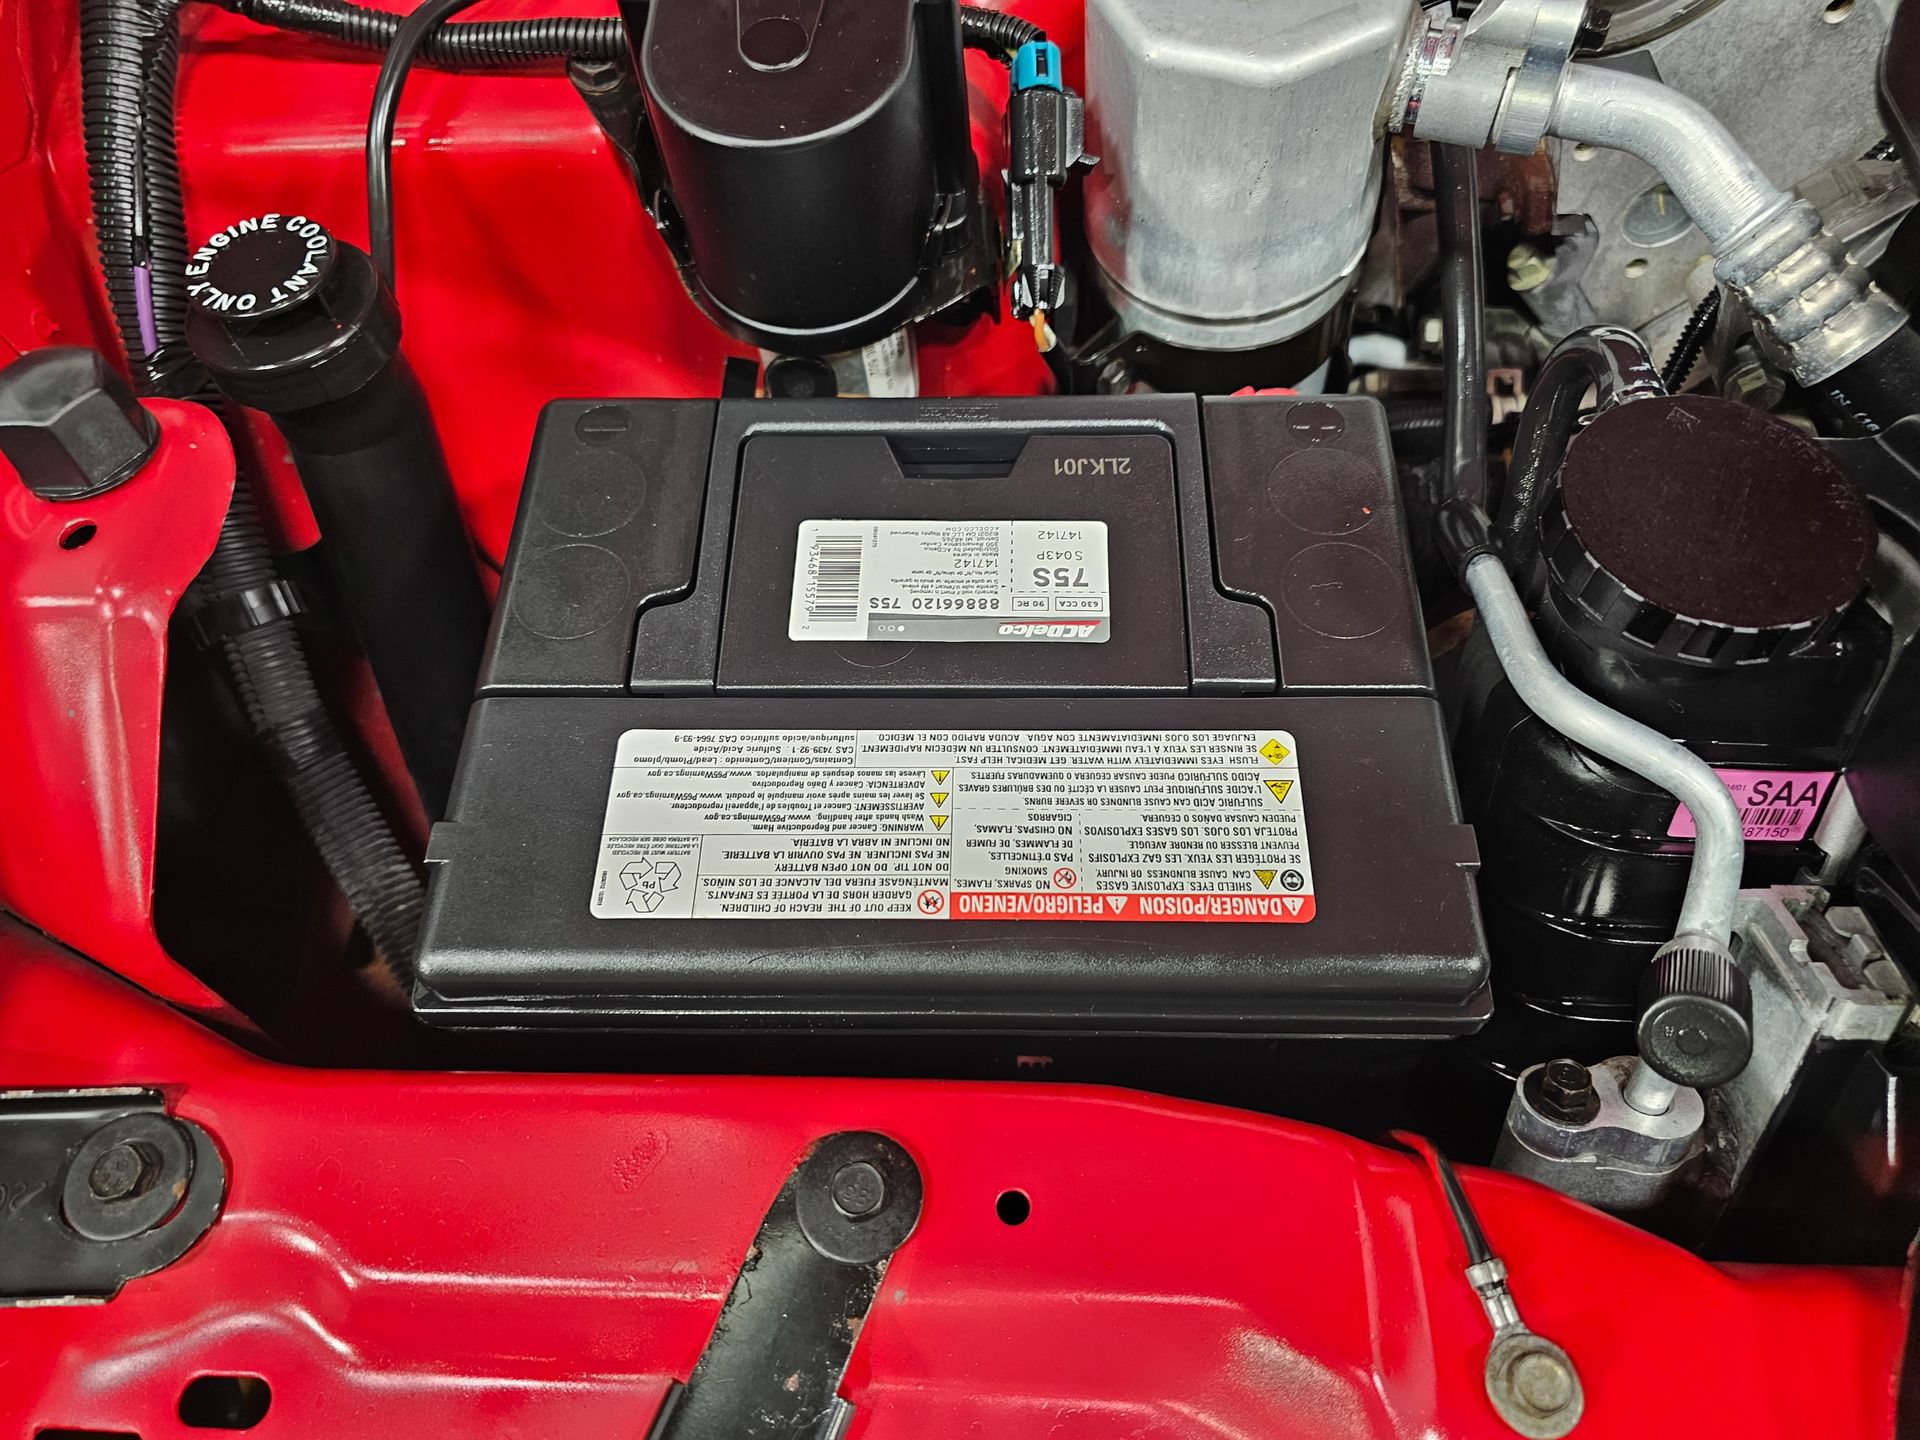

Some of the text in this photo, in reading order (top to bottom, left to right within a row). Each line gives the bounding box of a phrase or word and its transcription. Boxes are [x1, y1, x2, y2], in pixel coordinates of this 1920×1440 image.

[185, 213, 328, 311] ENGINE COOLANT ONLY
[1054, 457, 1132, 476] 2LKJ01
[1036, 530, 1082, 539] 147142
[1035, 550, 1083, 560] S043P
[953, 558, 998, 567] 147142
[1031, 567, 1089, 586] 75S
[868, 597, 999, 609] 88866120 75S
[997, 624, 1095, 637] ACDelco
[953, 755, 978, 763] FAST.
[979, 755, 1003, 763] HELP
[1004, 755, 1046, 763] MEDICAL
[1133, 756, 1198, 764] IMMEDIATELY
[1199, 756, 1224, 764] EYES
[1228, 756, 1258, 764] FLUSH
[1747, 779, 1818, 807] SAA
[1021, 797, 1052, 805] BURNS.
[1054, 797, 1084, 805] SEVERE
[1085, 797, 1098, 805] OR
[1172, 798, 1191, 806] CAN
[1192, 798, 1217, 806] ACID
[1216, 798, 1263, 806] SULFURIC
[702, 812, 812, 820] www.P65Warnings.ca.gov
[1138, 813, 1296, 824] PUEDEN CAUSAR DAÑOS O CEGUERA.
[749, 823, 924, 831] WARNING: Cancer and Reproductive Harm.
[972, 824, 1072, 834] NO CHISPAS, FLAMAS,
[1083, 826, 1298, 836] PROTEJA LOS OJOS. LOS GASES EXPLOSIVOS
[788, 838, 950, 848] NO INCLINE NI ABRA LA BATERÍA.
[964, 838, 996, 846] FUMER
[1010, 839, 1061, 847] FLAMMES,
[1060, 839, 1073, 847] DE
[1126, 840, 1299, 849] PEUVENT BLESSER OU RENDRE AVEUGLE.
[719, 850, 949, 858] NE PAS INCLINER. NE PAS OUVRIR LA BATTERIE.
[986, 850, 1073, 862] PAS D'ÉTINCELLES,
[1087, 853, 1301, 865] SE PROTÉGER LES YEUX. LES GAZ EXPLOSIFS
[772, 862, 949, 871] DO NOT TIP. DO NOT OPEN BATTERY.
[1003, 866, 1048, 874] SMOKING
[1094, 868, 1128, 877] INJURY.
[1129, 869, 1142, 877] OR
[1144, 869, 1196, 877] BLINDNESS
[1197, 869, 1228, 877] CAUSE
[639, 880, 656, 888] Pb
[698, 877, 948, 888] MANTÉNGASE FUERA DEL ALCANCE DE LOS NIÑOS.
[952, 877, 1050, 888] NO SPARKS, FLAMES,
[1095, 880, 1252, 890] SHIELD EYES. EXPLOSIVE GASES
[703, 890, 912, 900] GARDER HORS DE LA PORTÉE ES ENFANTS.
[718, 903, 912, 911] KEEP OUT OF THE REACH OF CHILDREN.
[957, 894, 1104, 914] PELIGRO/VENENO
[1137, 895, 1283, 915] DANGER/POISON
